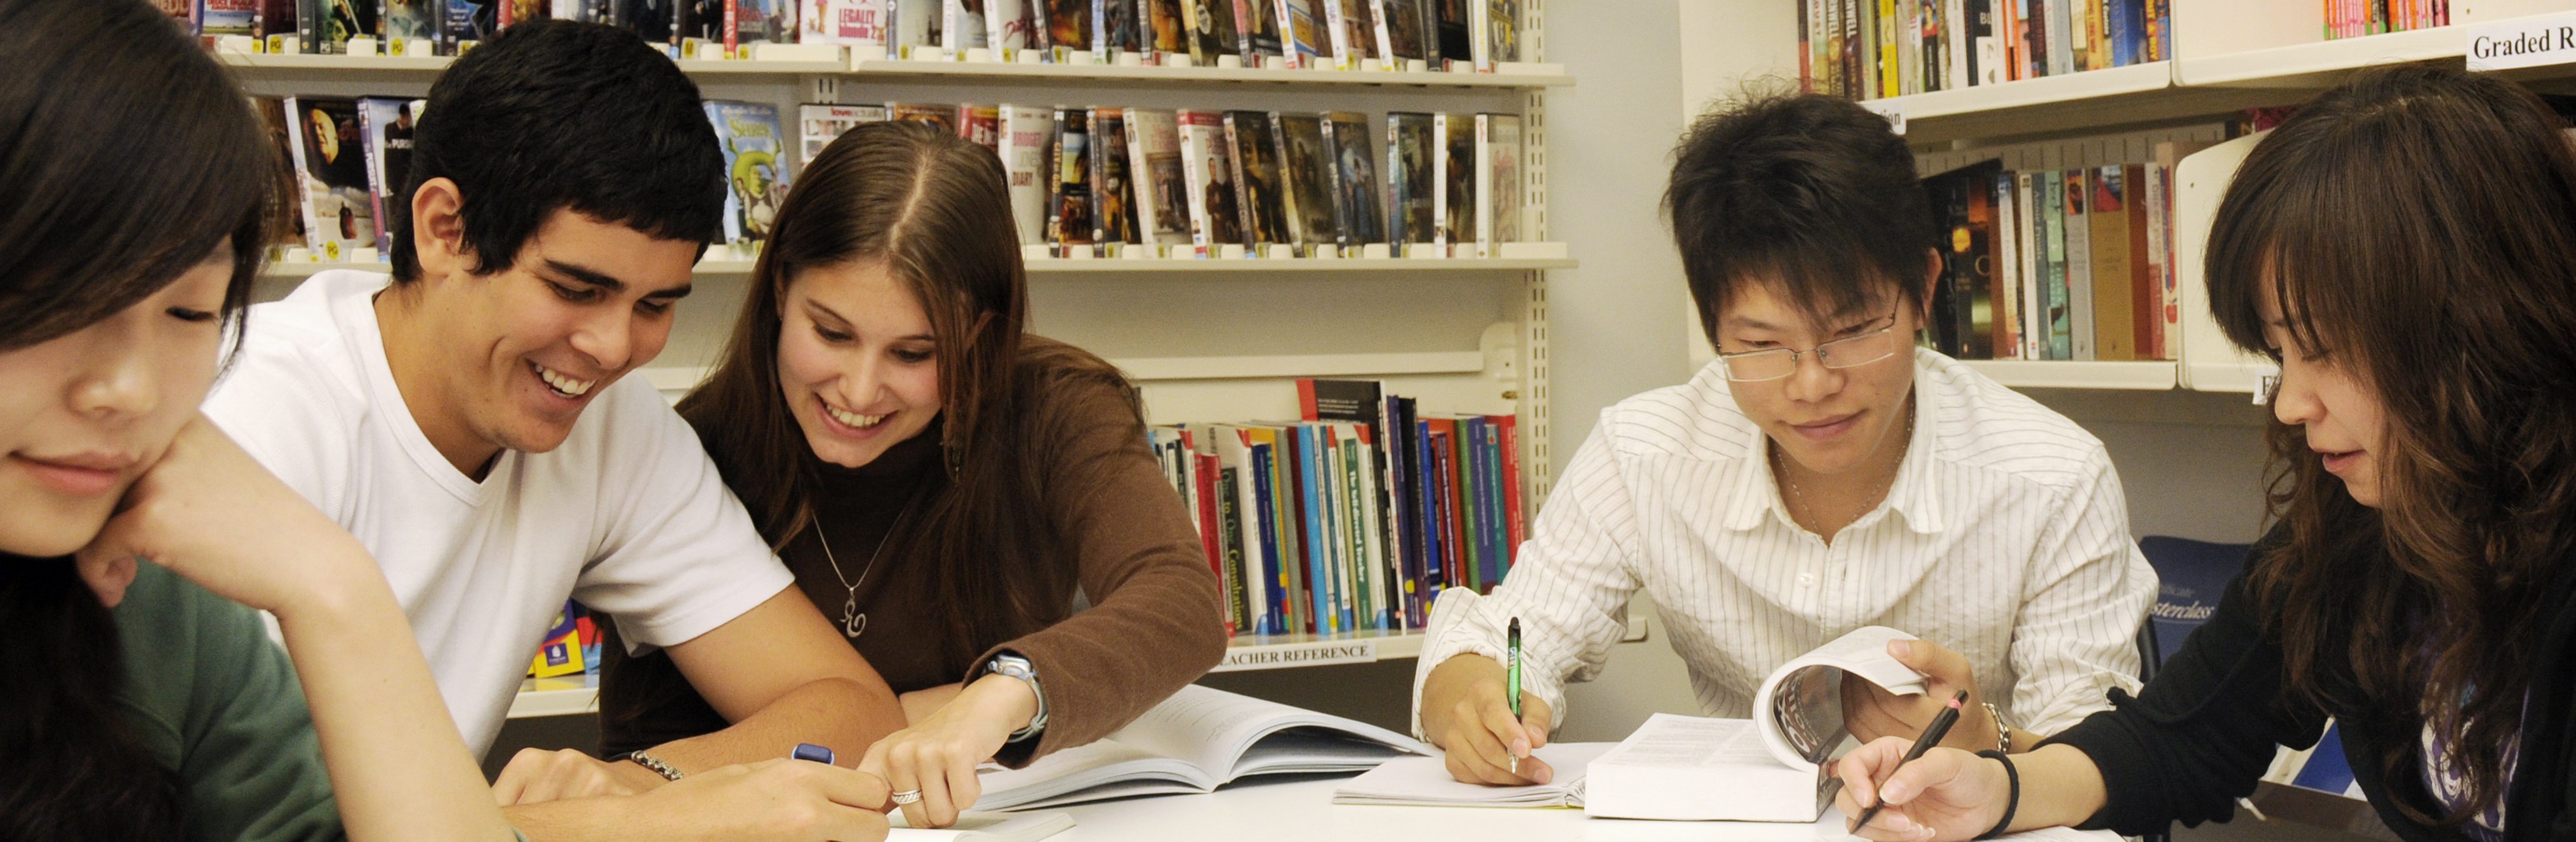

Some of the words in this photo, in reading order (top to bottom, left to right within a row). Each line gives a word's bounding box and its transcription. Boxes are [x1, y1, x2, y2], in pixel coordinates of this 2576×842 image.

[839, 8, 876, 23] LEGALLY
[2474, 29, 2550, 59] Graded
[1348, 471, 1357, 488] The
[1355, 545, 1366, 582] Teacher
[1227, 549, 1244, 629] Consultations
[1284, 645, 1369, 662] REFERENCE
